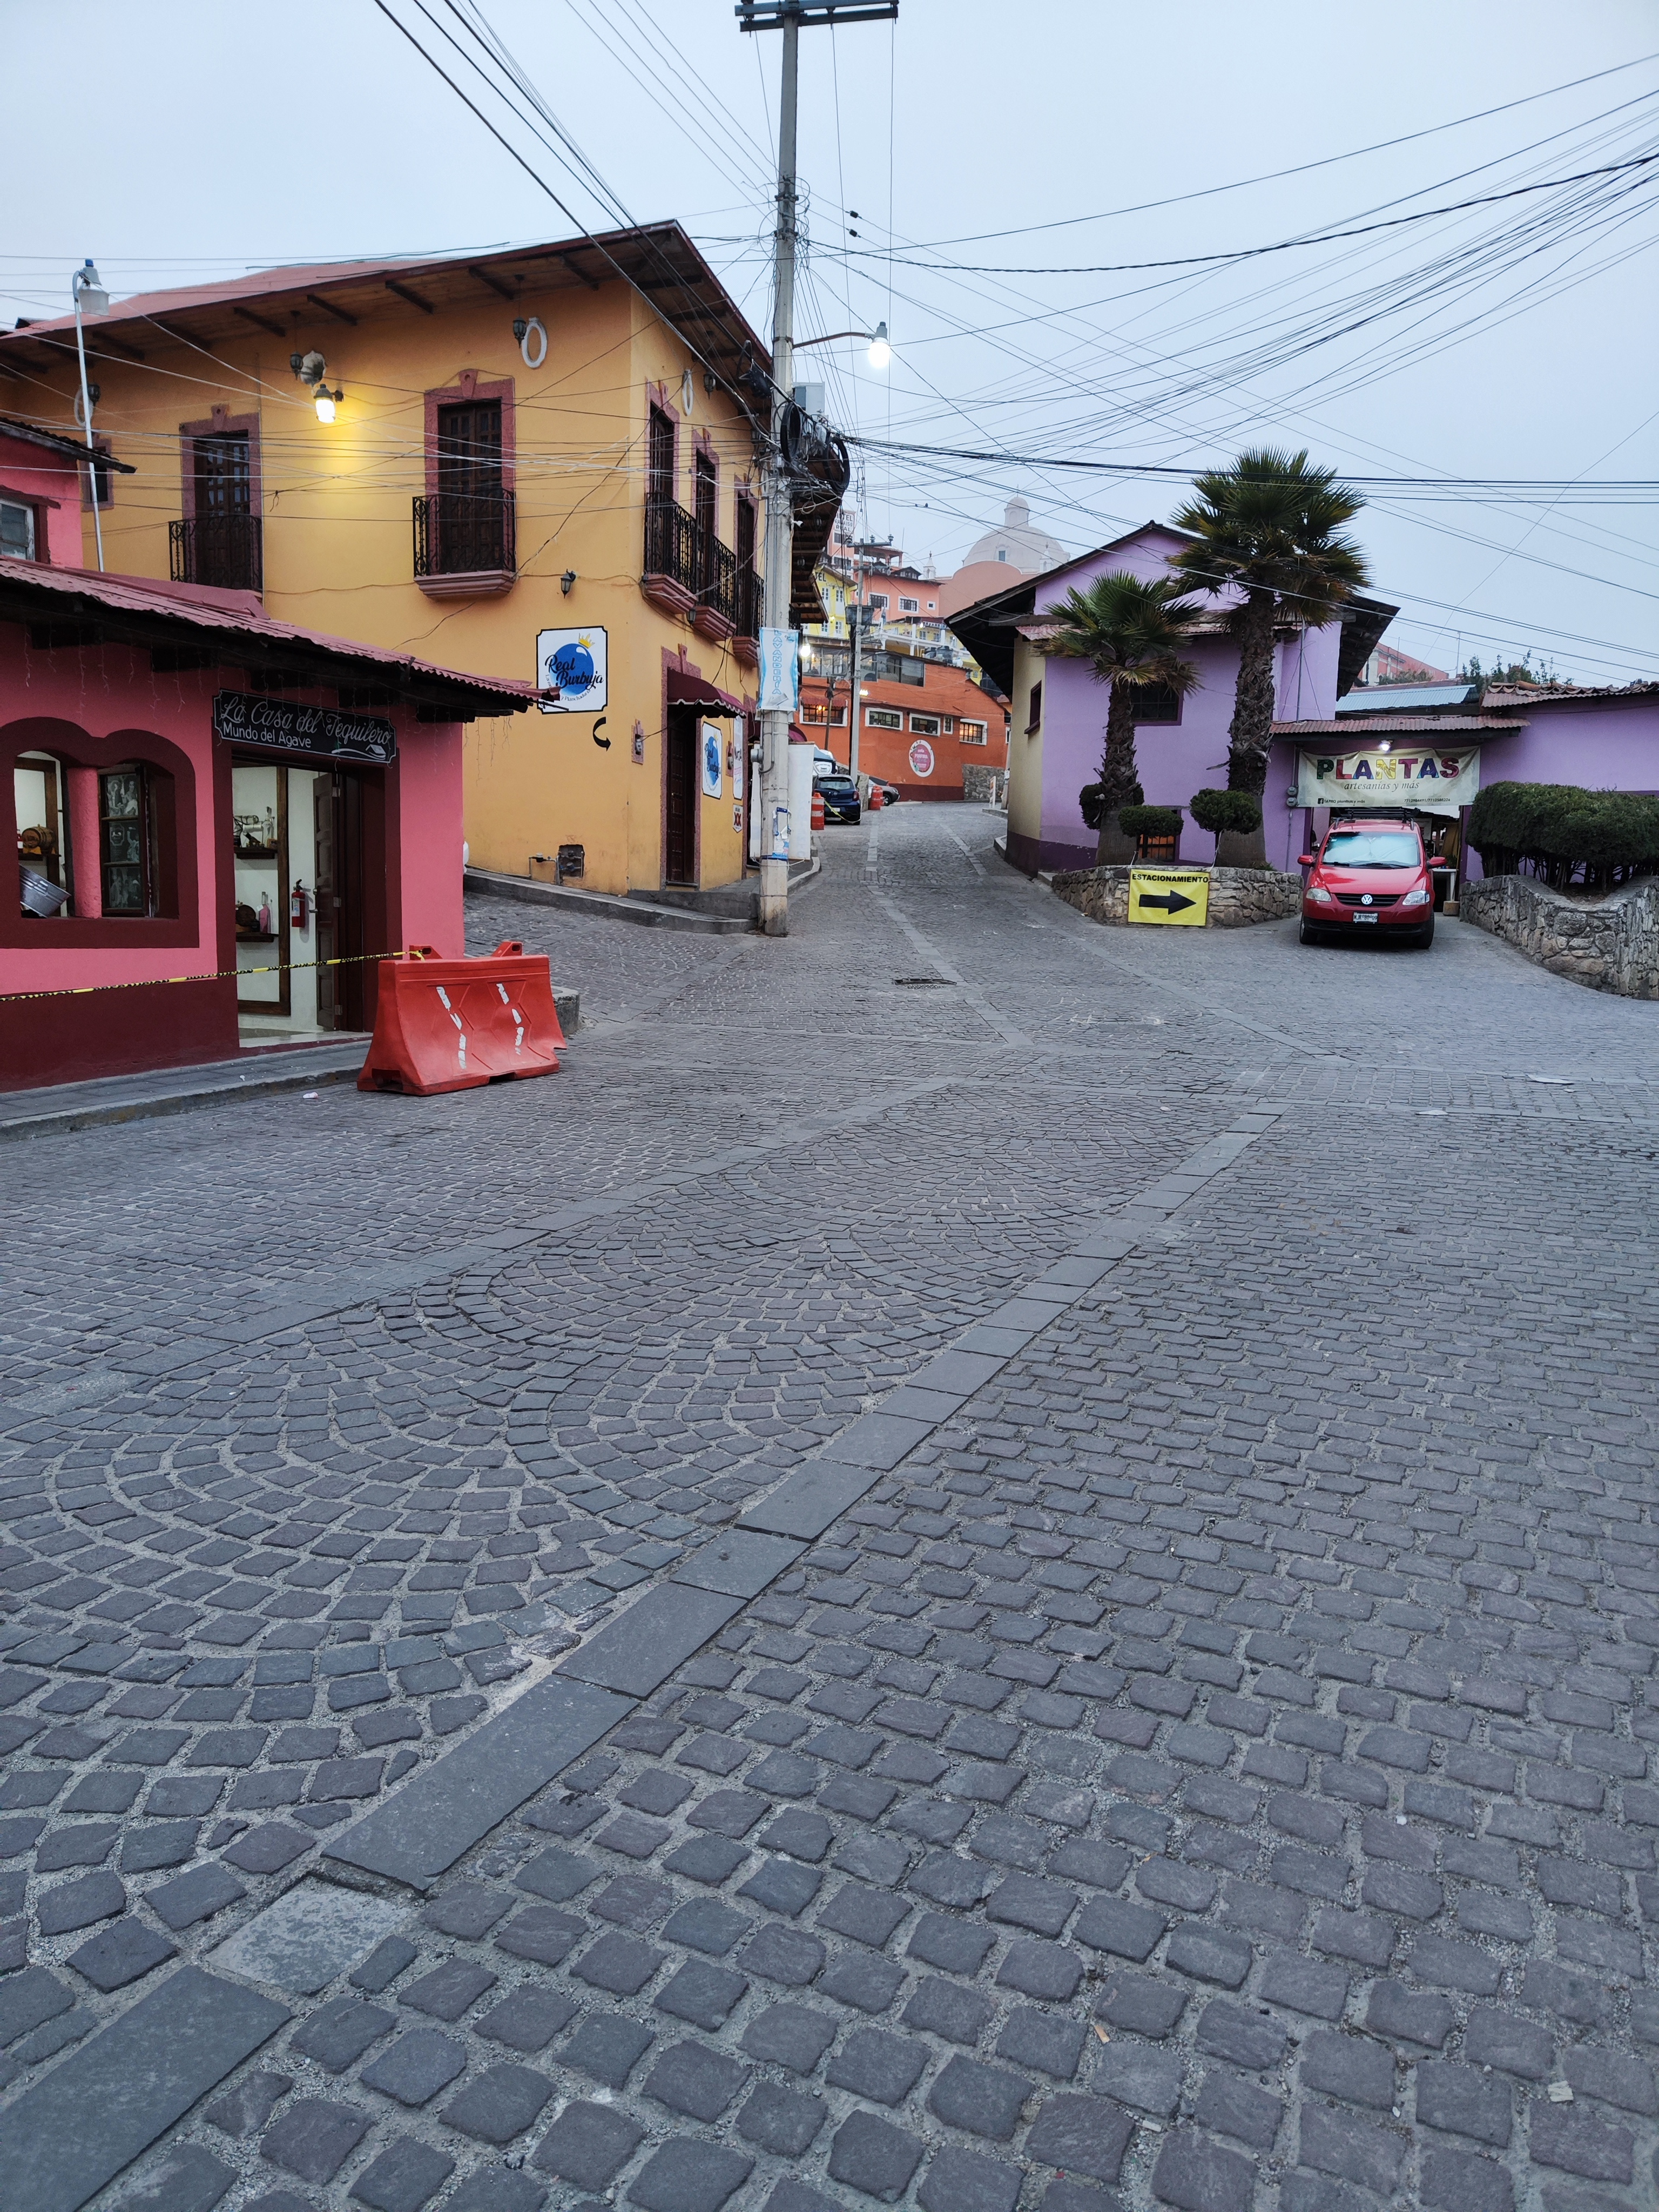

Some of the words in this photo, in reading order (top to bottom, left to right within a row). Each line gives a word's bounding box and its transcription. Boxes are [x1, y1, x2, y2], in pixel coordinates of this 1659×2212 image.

[834, 519, 853, 527] PAAISO
[837, 512, 853, 522] OEL
[545, 654, 576, 673] Real
[556, 671, 604, 691] Burbuja
[221, 696, 245, 724] La
[251, 702, 293, 729] Casa
[296, 709, 322, 733] del
[326, 713, 392, 745] Tequilero
[223, 721, 258, 740] Mundo
[261, 729, 275, 743] del
[278, 734, 312, 748] Agave
[1317, 757, 1459, 780] PLANTAS
[1344, 781, 1391, 790] artesanías
[1391, 783, 1399, 793] y
[1401, 780, 1420, 789] más
[1132, 873, 1209, 883] ESTACIONAMIENTO
